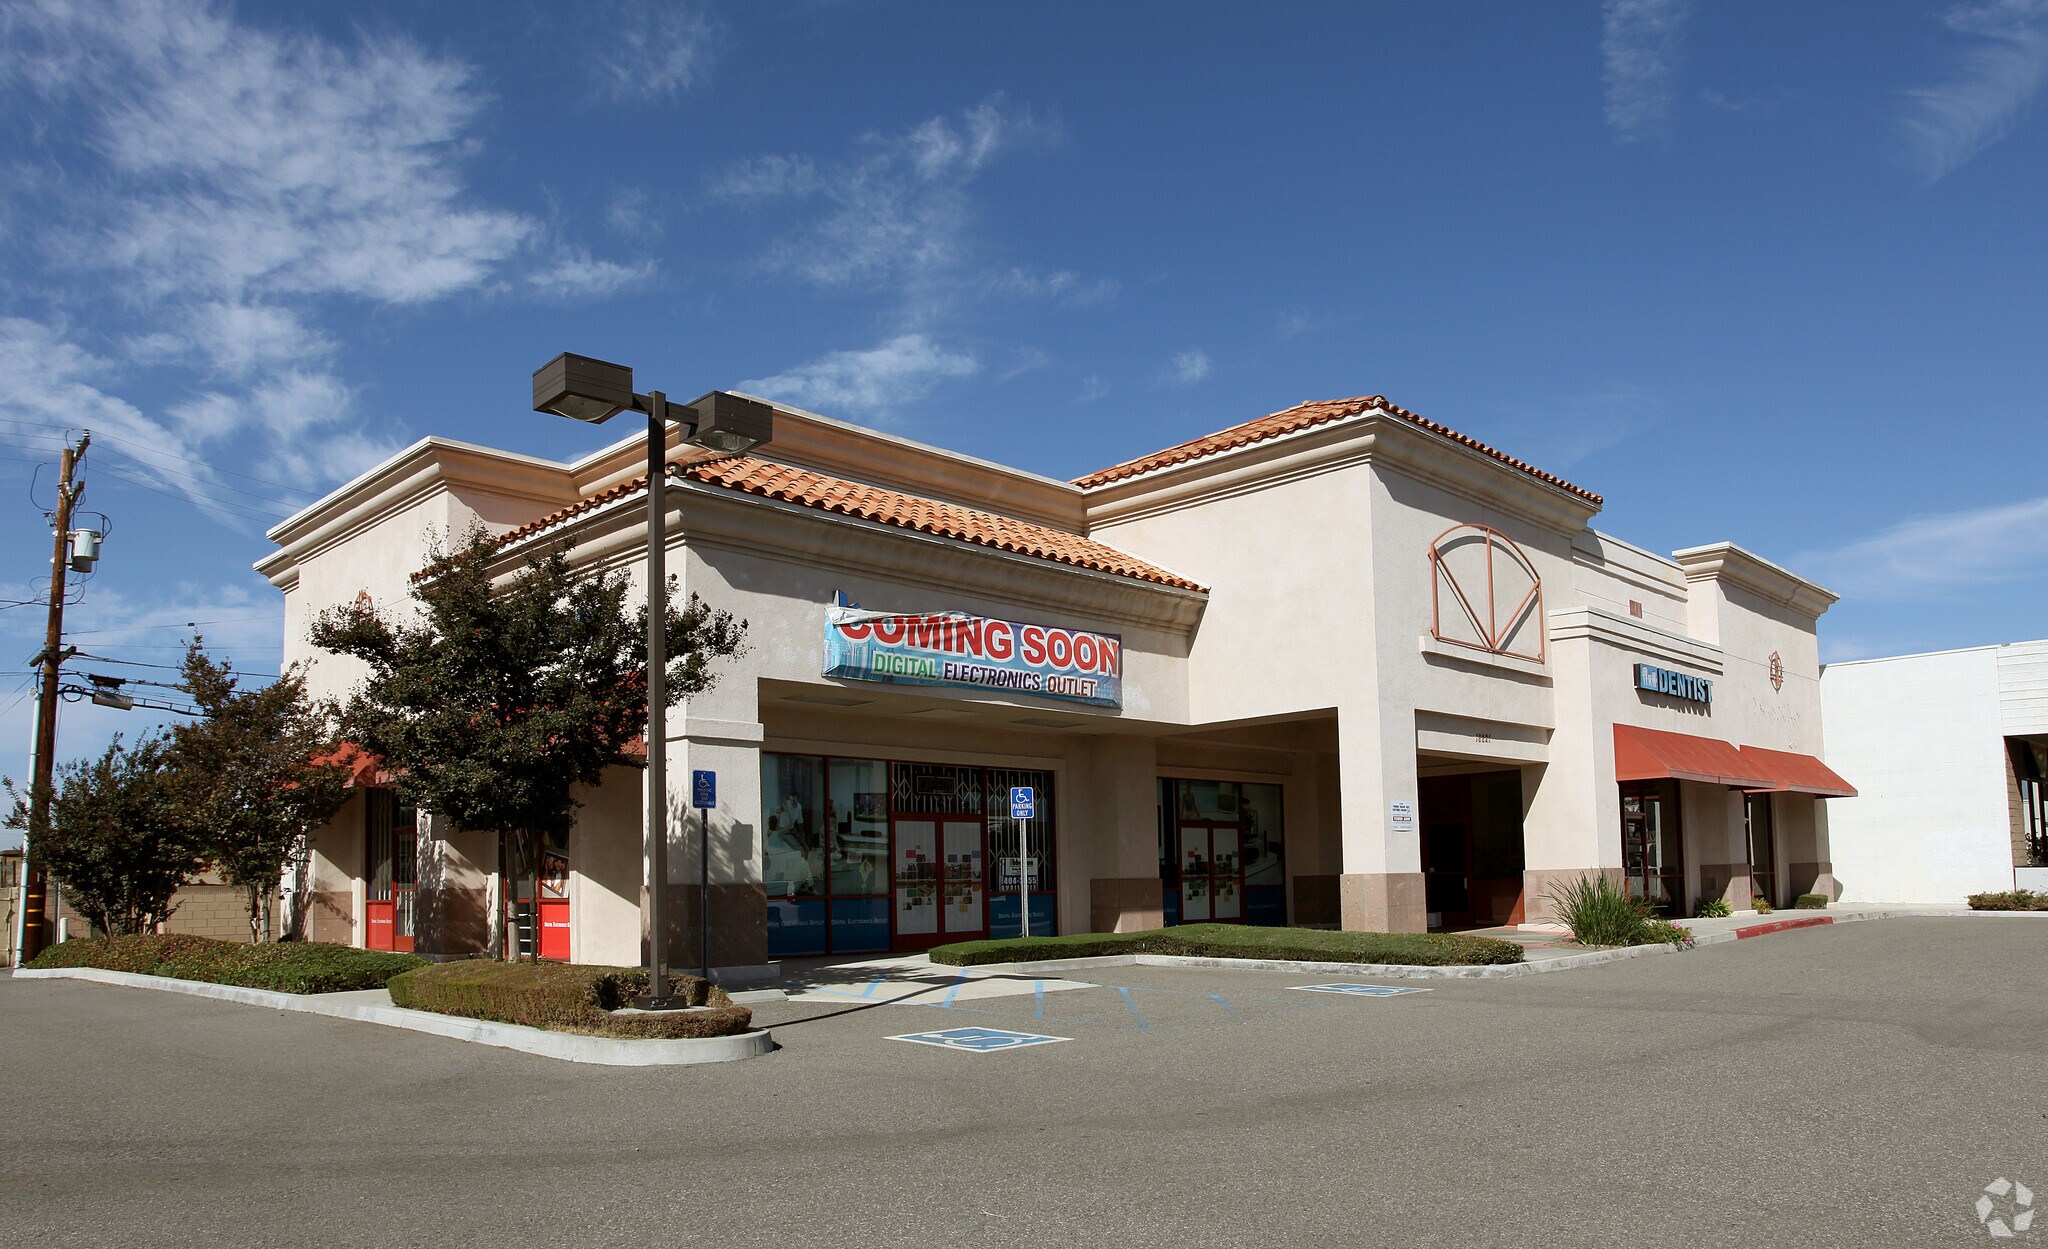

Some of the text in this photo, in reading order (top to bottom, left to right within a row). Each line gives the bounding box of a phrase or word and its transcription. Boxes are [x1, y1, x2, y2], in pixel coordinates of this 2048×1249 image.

[1022, 627, 1119, 675] SOON
[873, 652, 1097, 698] DIGITAL ELECTRONICS OUTLET
[1658, 668, 1713, 703] DENTIST
